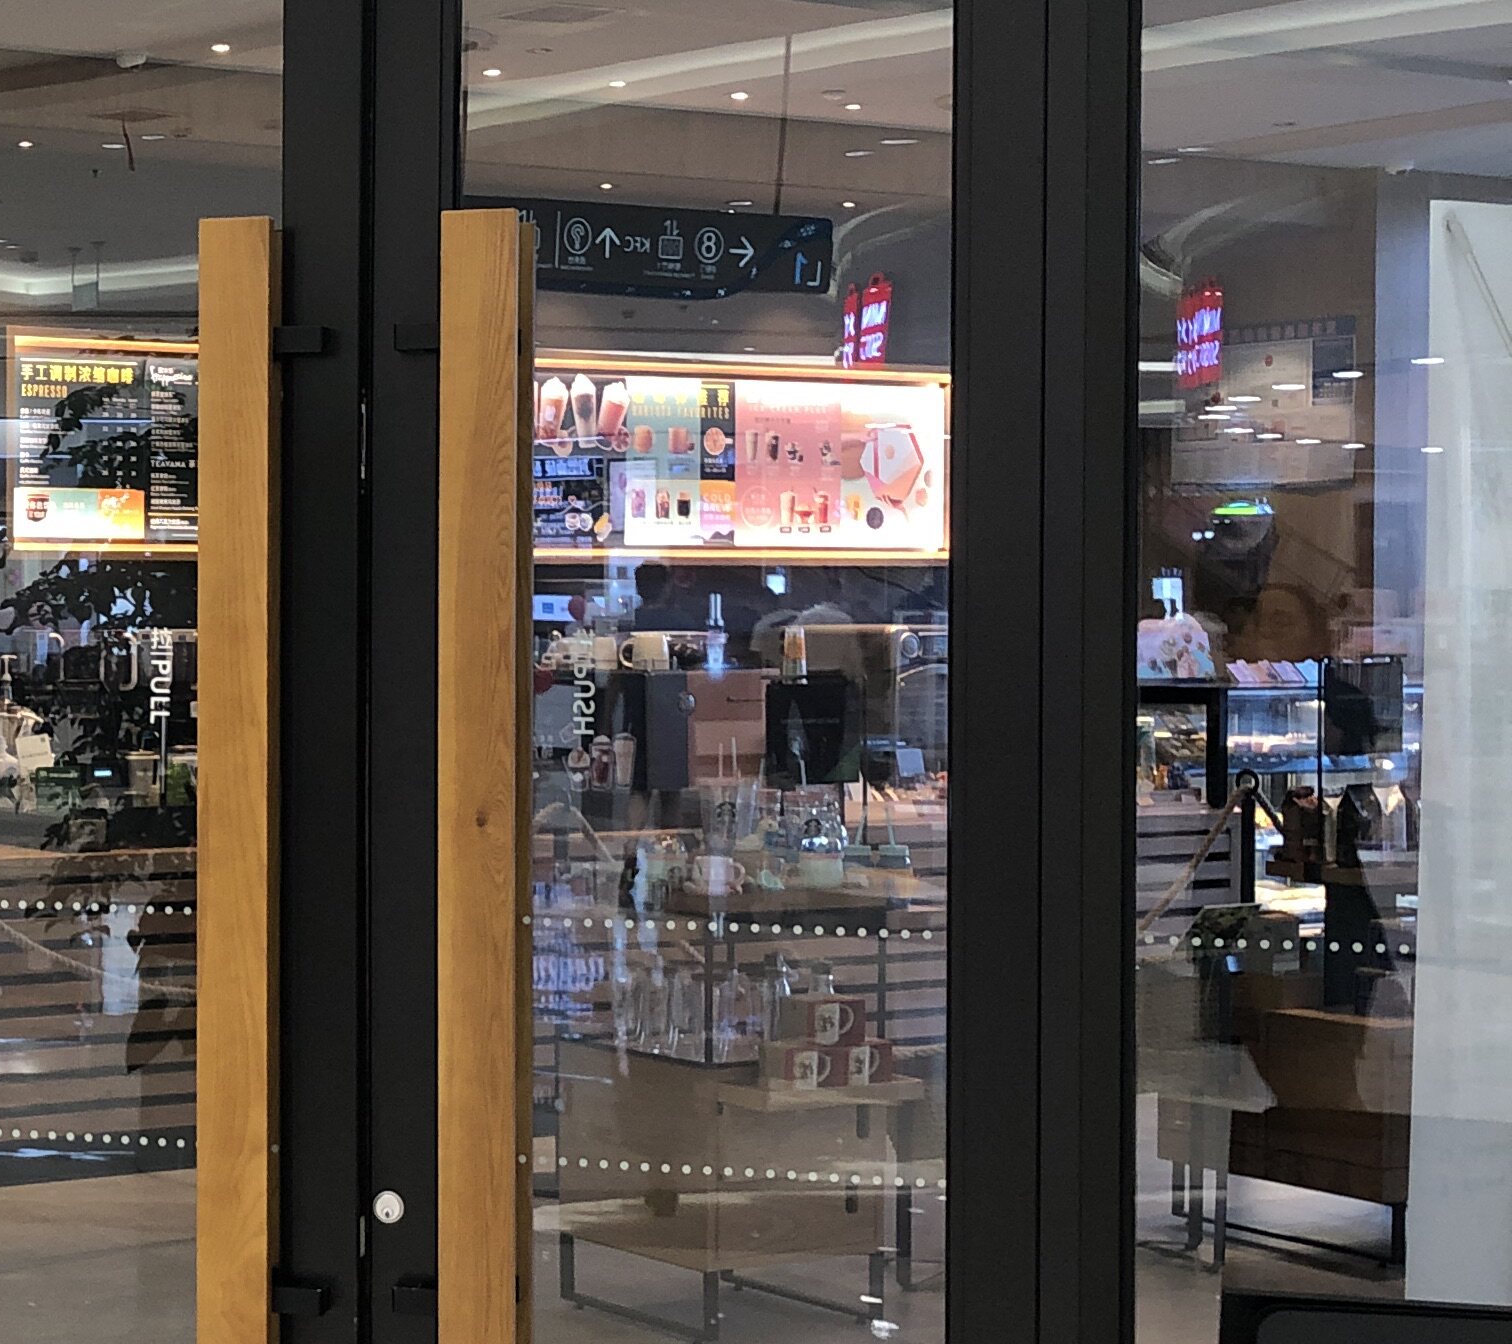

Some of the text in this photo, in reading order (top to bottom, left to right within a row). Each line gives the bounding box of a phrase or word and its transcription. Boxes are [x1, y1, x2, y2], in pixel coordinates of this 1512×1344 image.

[20, 363, 135, 385] 手工调制浓缩咖啡
[21, 383, 68, 399] ESPRESSO
[149, 659, 172, 725] PULL
